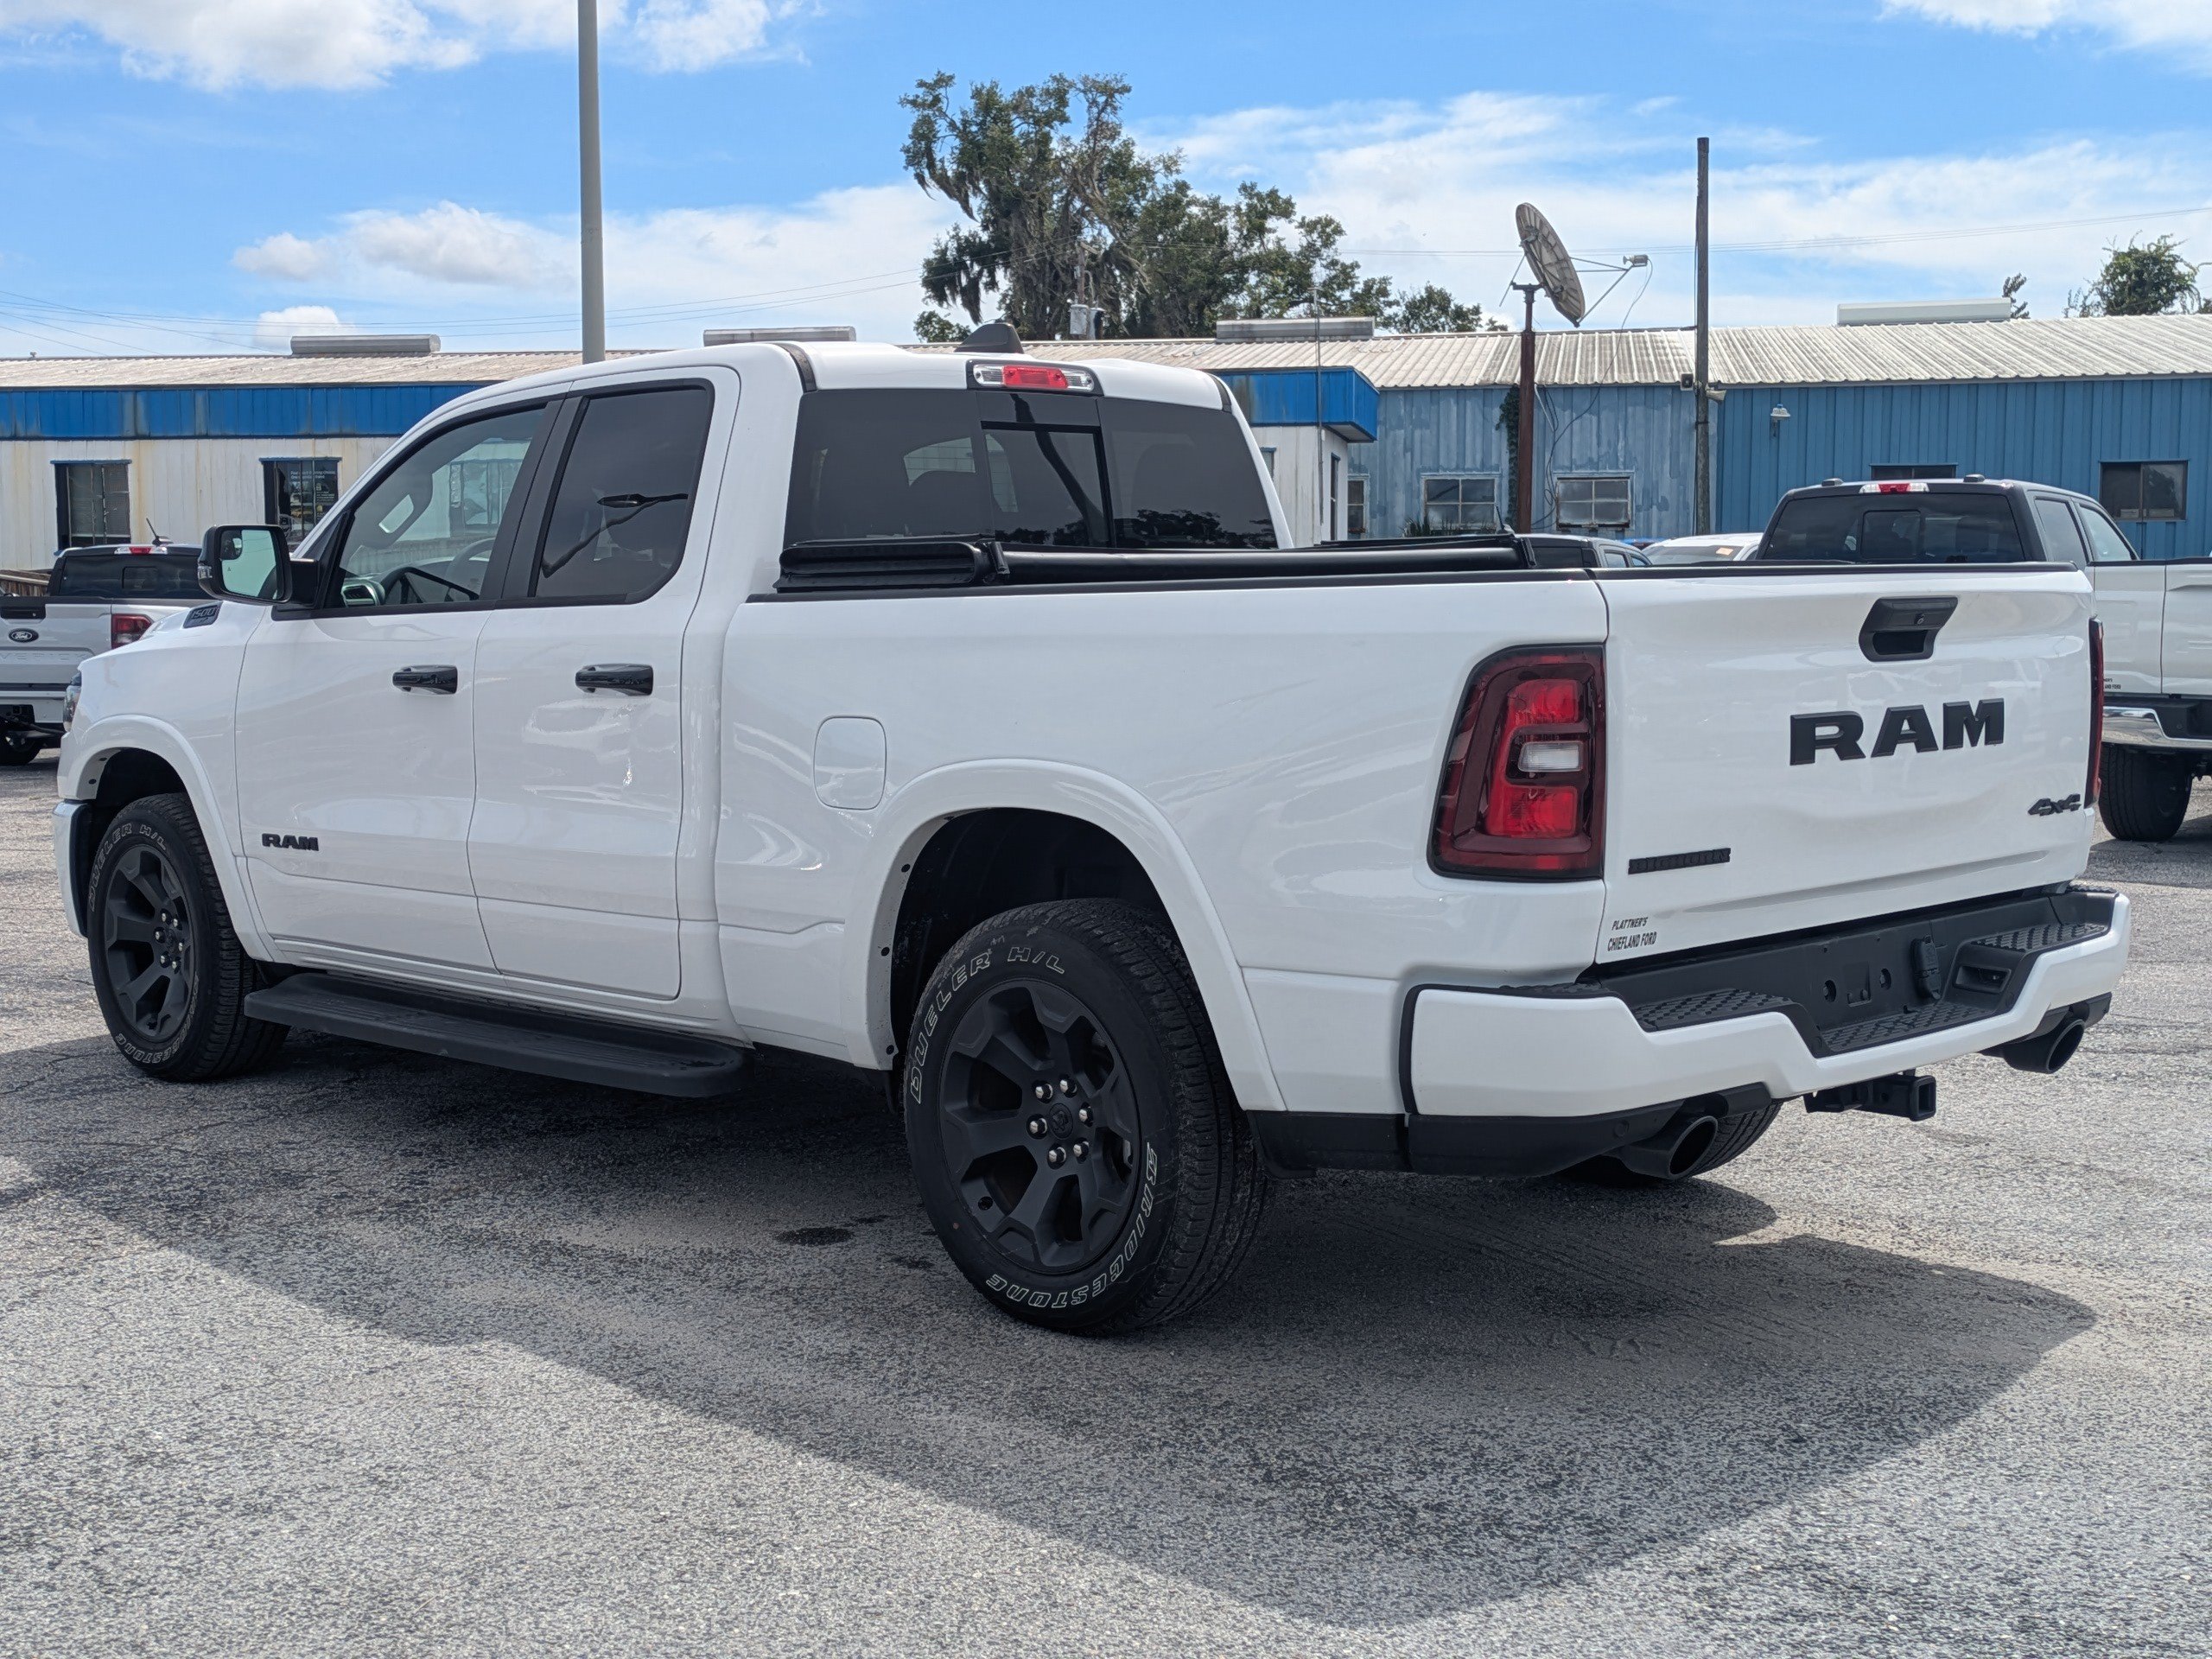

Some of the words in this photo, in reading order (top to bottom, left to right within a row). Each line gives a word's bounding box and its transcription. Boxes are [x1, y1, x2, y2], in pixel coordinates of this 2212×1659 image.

[1789, 697, 2005, 766] RAM
[2027, 793, 2081, 817] 4x4
[262, 833, 320, 852] RAM
[1611, 916, 1649, 931] PLATTNER'S
[1607, 933, 1641, 951] CHIEFLAND
[1641, 931, 1657, 947] FORD
[910, 951, 991, 1104] DUELER
[1007, 946, 1065, 975] H/L
[985, 1141, 1158, 1309] BRIDGESTONE
